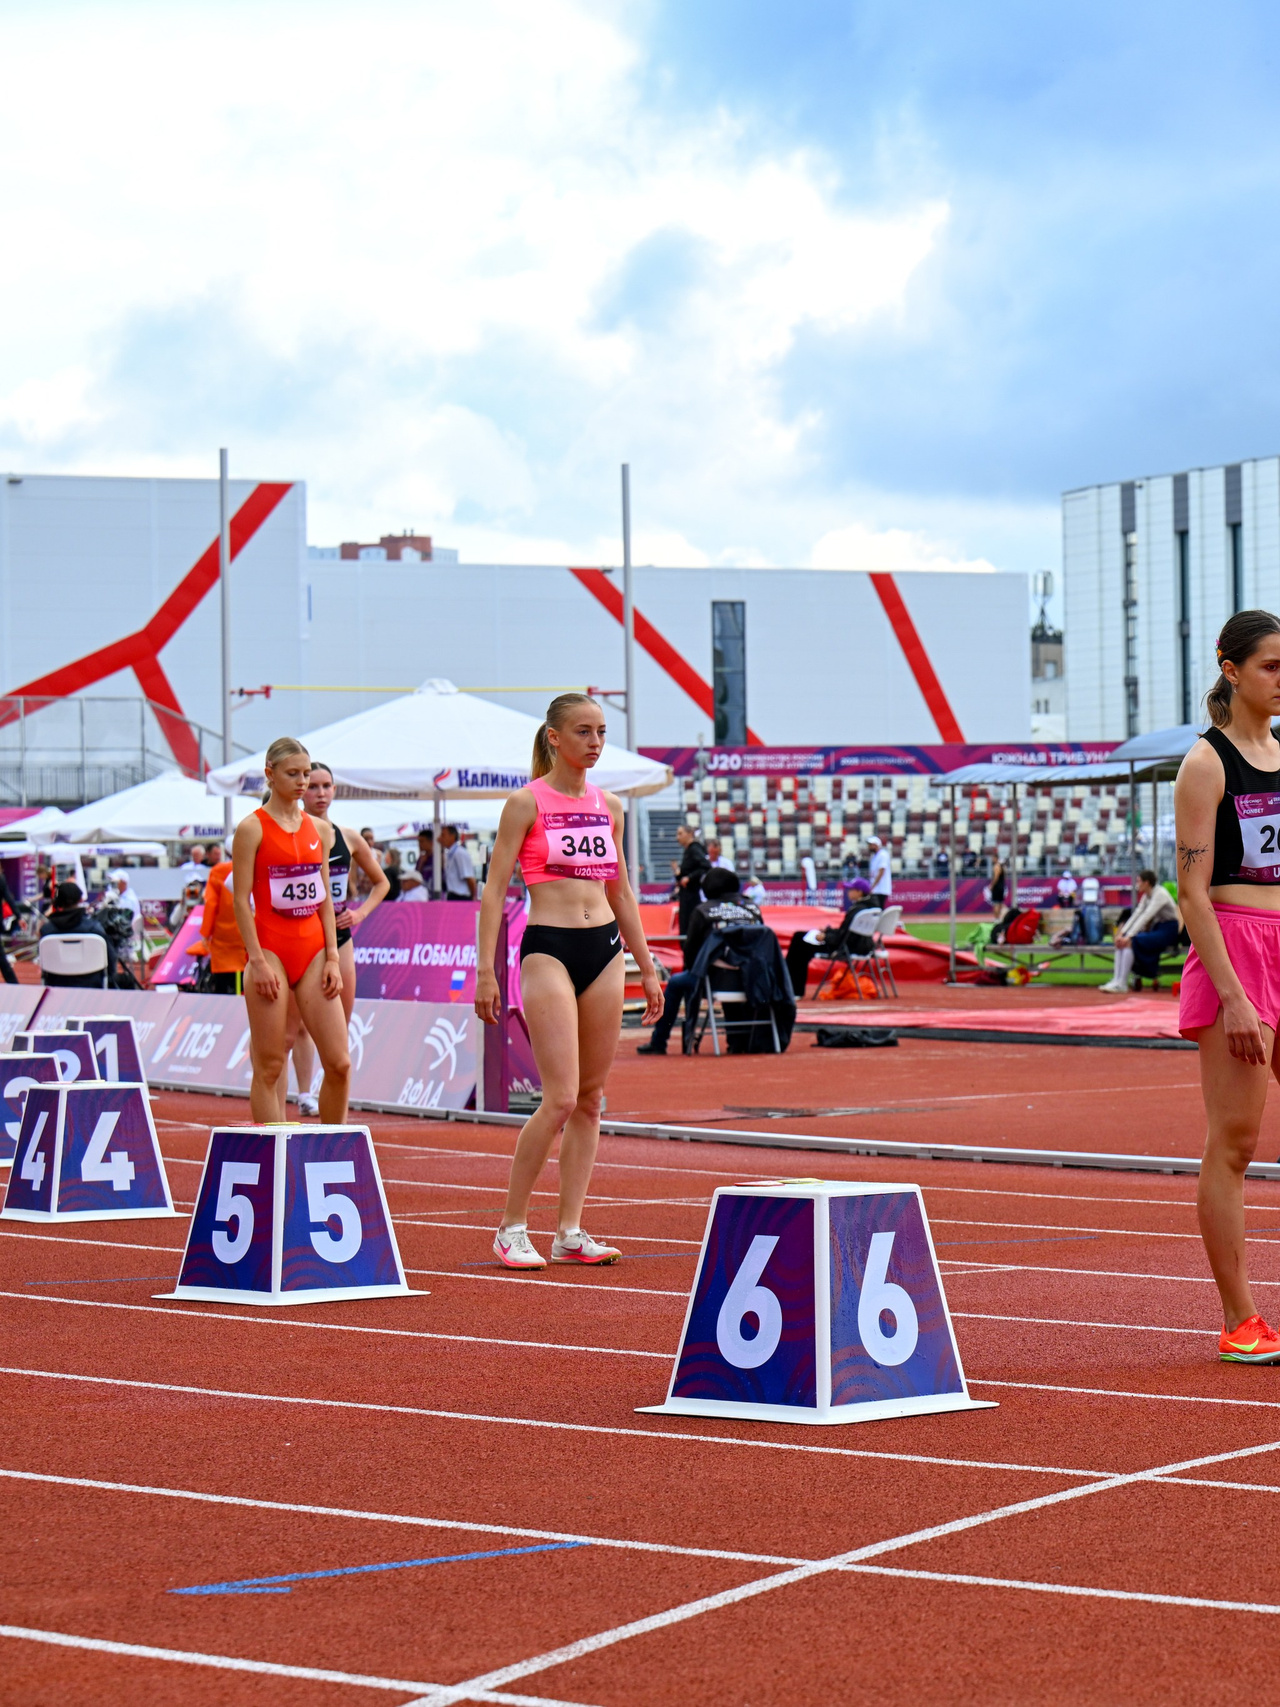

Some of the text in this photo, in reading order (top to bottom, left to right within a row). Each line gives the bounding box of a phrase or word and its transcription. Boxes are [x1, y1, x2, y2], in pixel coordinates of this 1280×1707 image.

[561, 835, 607, 858] 348
[574, 867, 592, 877] U20
[282, 882, 317, 901] 439
[95, 1033, 119, 1082] 1
[176, 1023, 224, 1060] ПСБ
[397, 1077, 445, 1108] ВФЛА
[20, 1111, 136, 1192] 4 4
[211, 1160, 363, 1265] 5 5
[716, 1231, 919, 1370] 6 6
